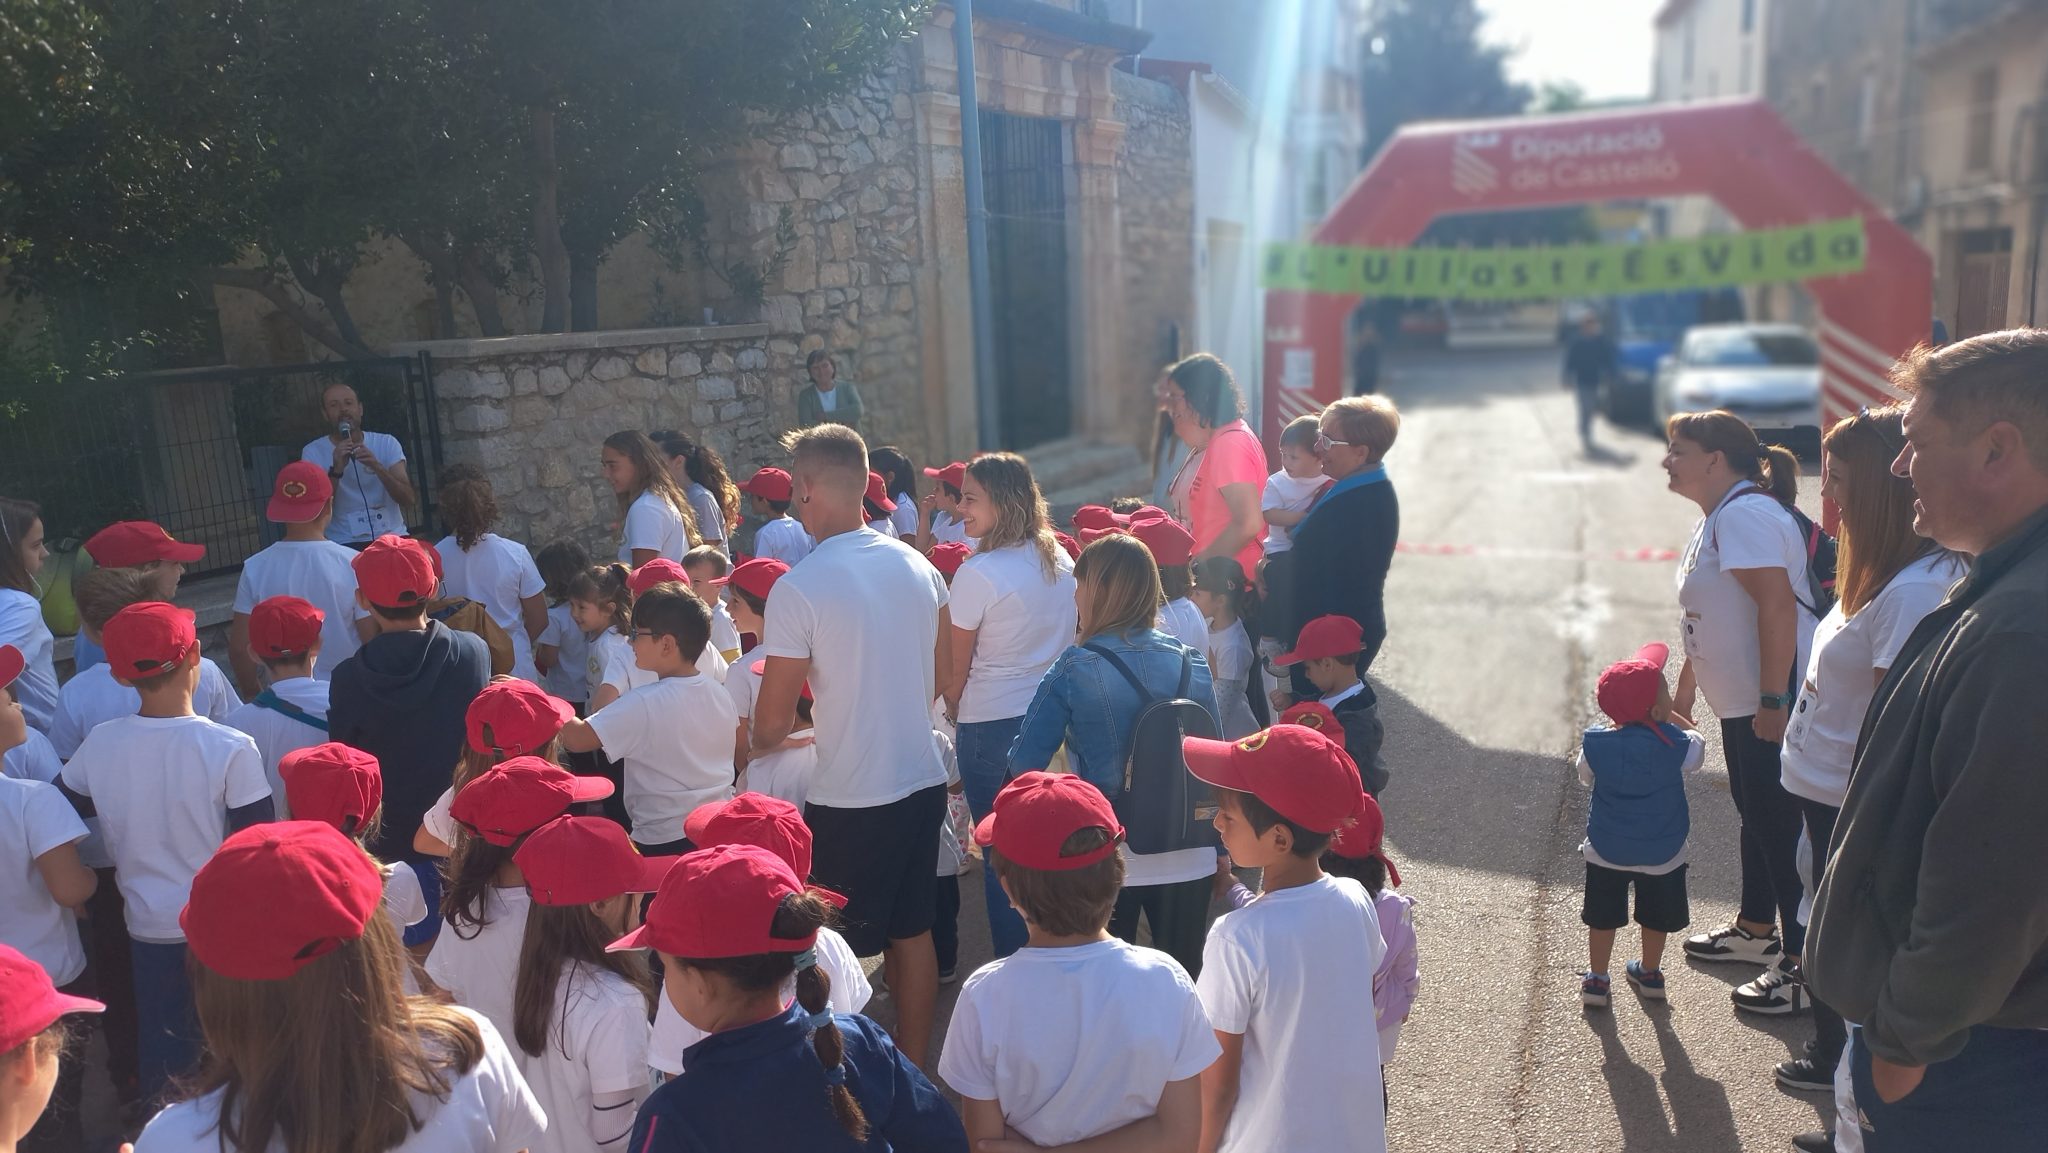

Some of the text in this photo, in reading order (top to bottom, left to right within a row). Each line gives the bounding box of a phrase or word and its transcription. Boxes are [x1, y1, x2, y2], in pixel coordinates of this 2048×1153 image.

[1510, 121, 1664, 162] Diputació
[1508, 153, 1681, 191] de Castelló
